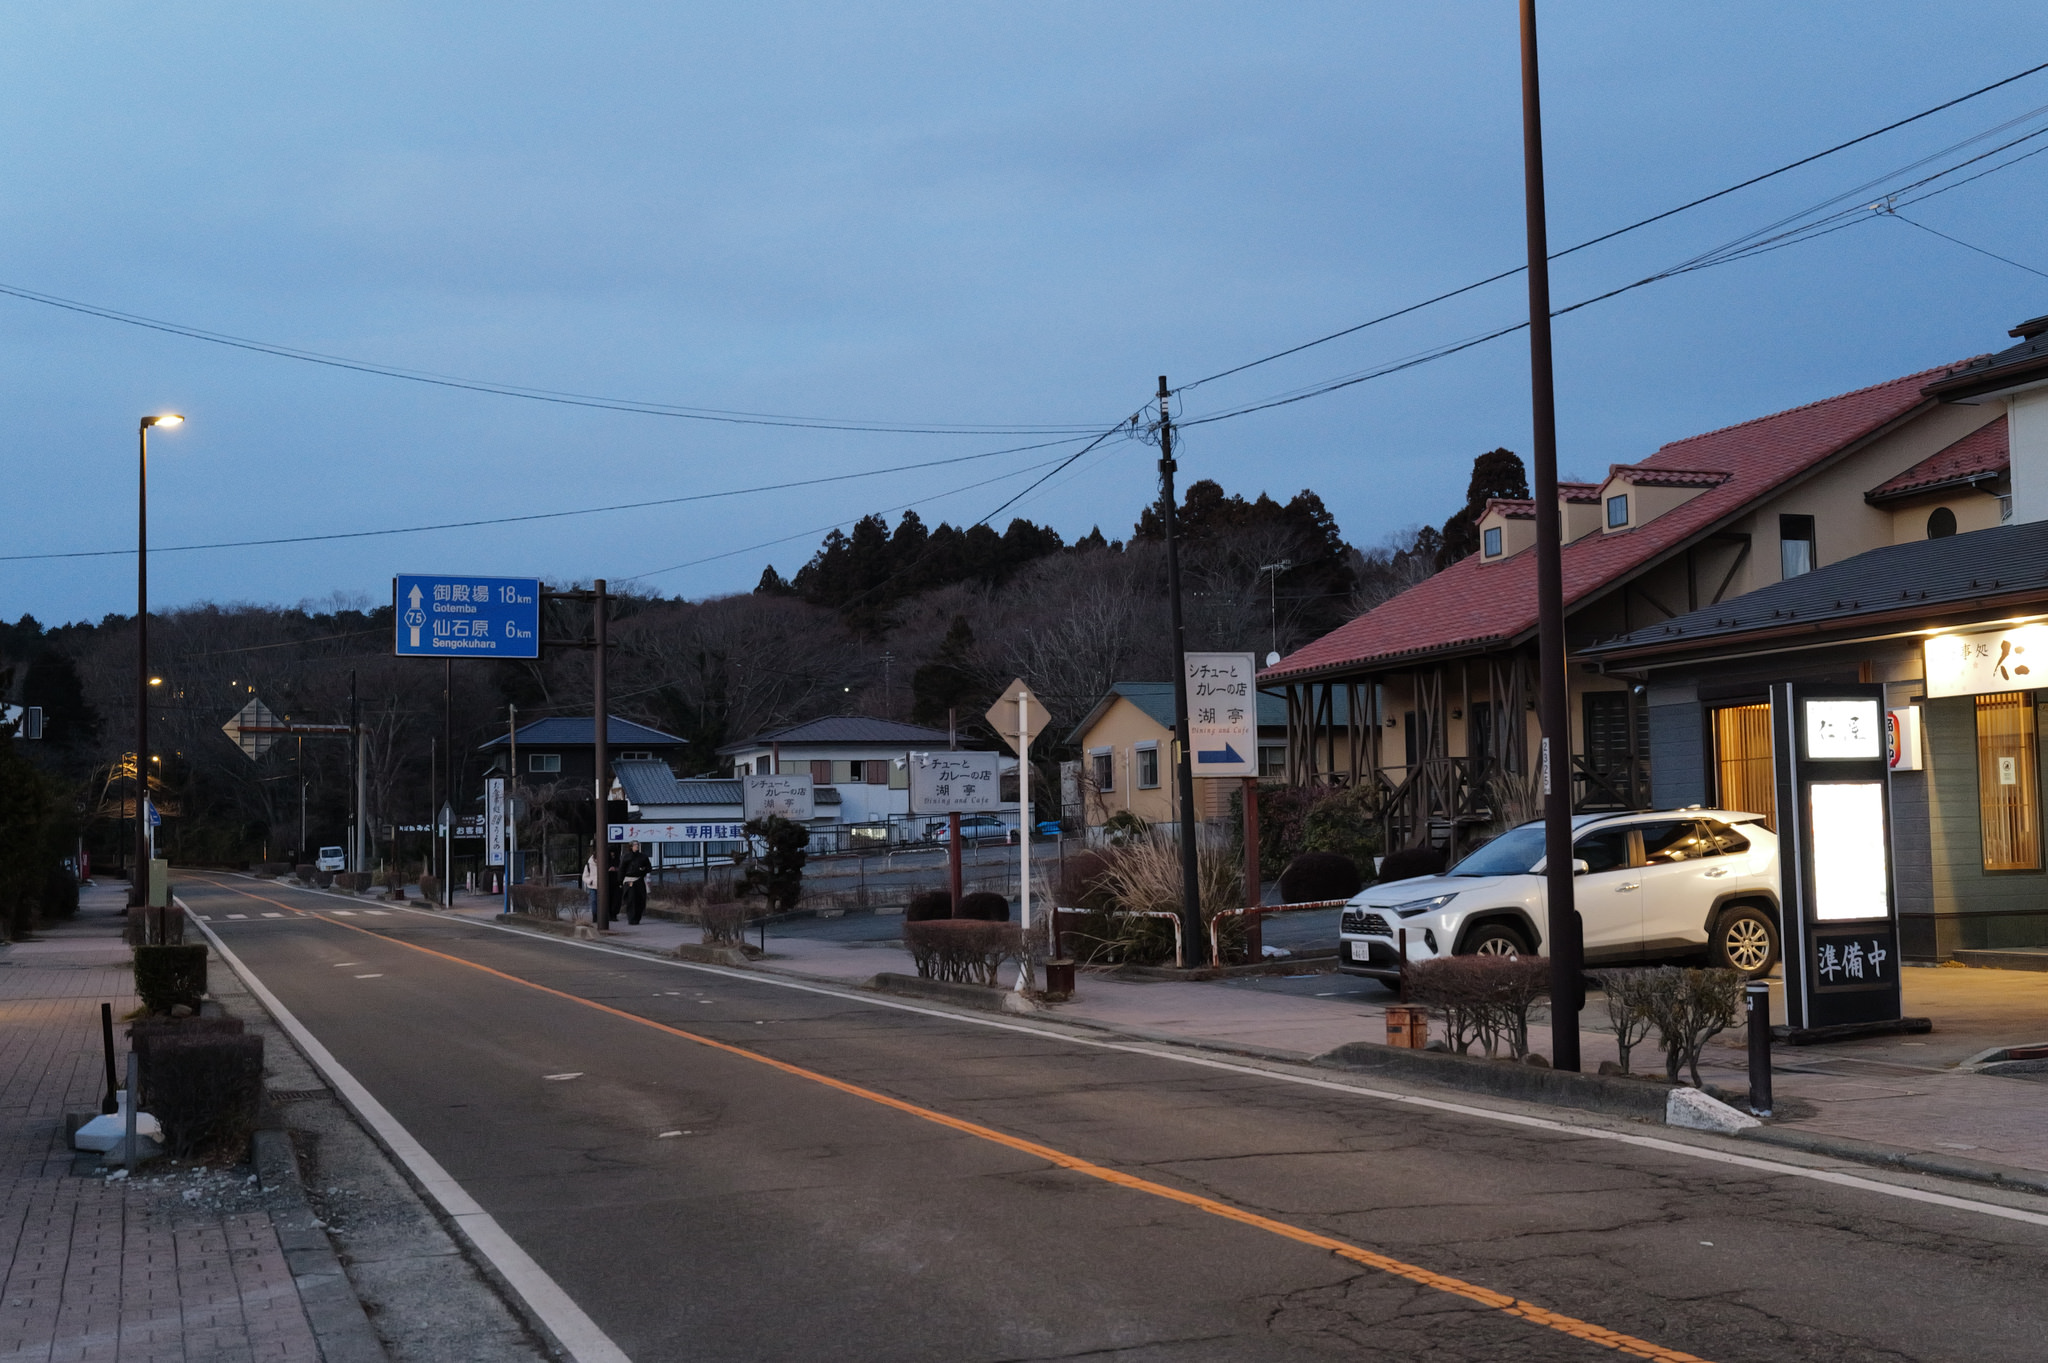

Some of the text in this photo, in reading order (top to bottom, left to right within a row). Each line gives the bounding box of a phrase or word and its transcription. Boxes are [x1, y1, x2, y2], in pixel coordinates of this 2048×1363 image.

[433, 584, 489, 602] 御殿場
[433, 603, 477, 613] Gotemba
[409, 612, 423, 624] 75
[433, 619, 489, 637] 仙石原
[433, 637, 497, 649] Sengokuhara
[1189, 664, 1238, 678] シチューと
[1196, 682, 1248, 696] カレーの店
[1191, 727, 1216, 736] Dining
[939, 770, 992, 781] カレーの店
[751, 780, 790, 789] シチューと
[765, 788, 807, 797] カレーの店
[924, 797, 951, 805] Dining
[685, 825, 757, 839] 専用駐車
[1818, 940, 1887, 982] 準備中
